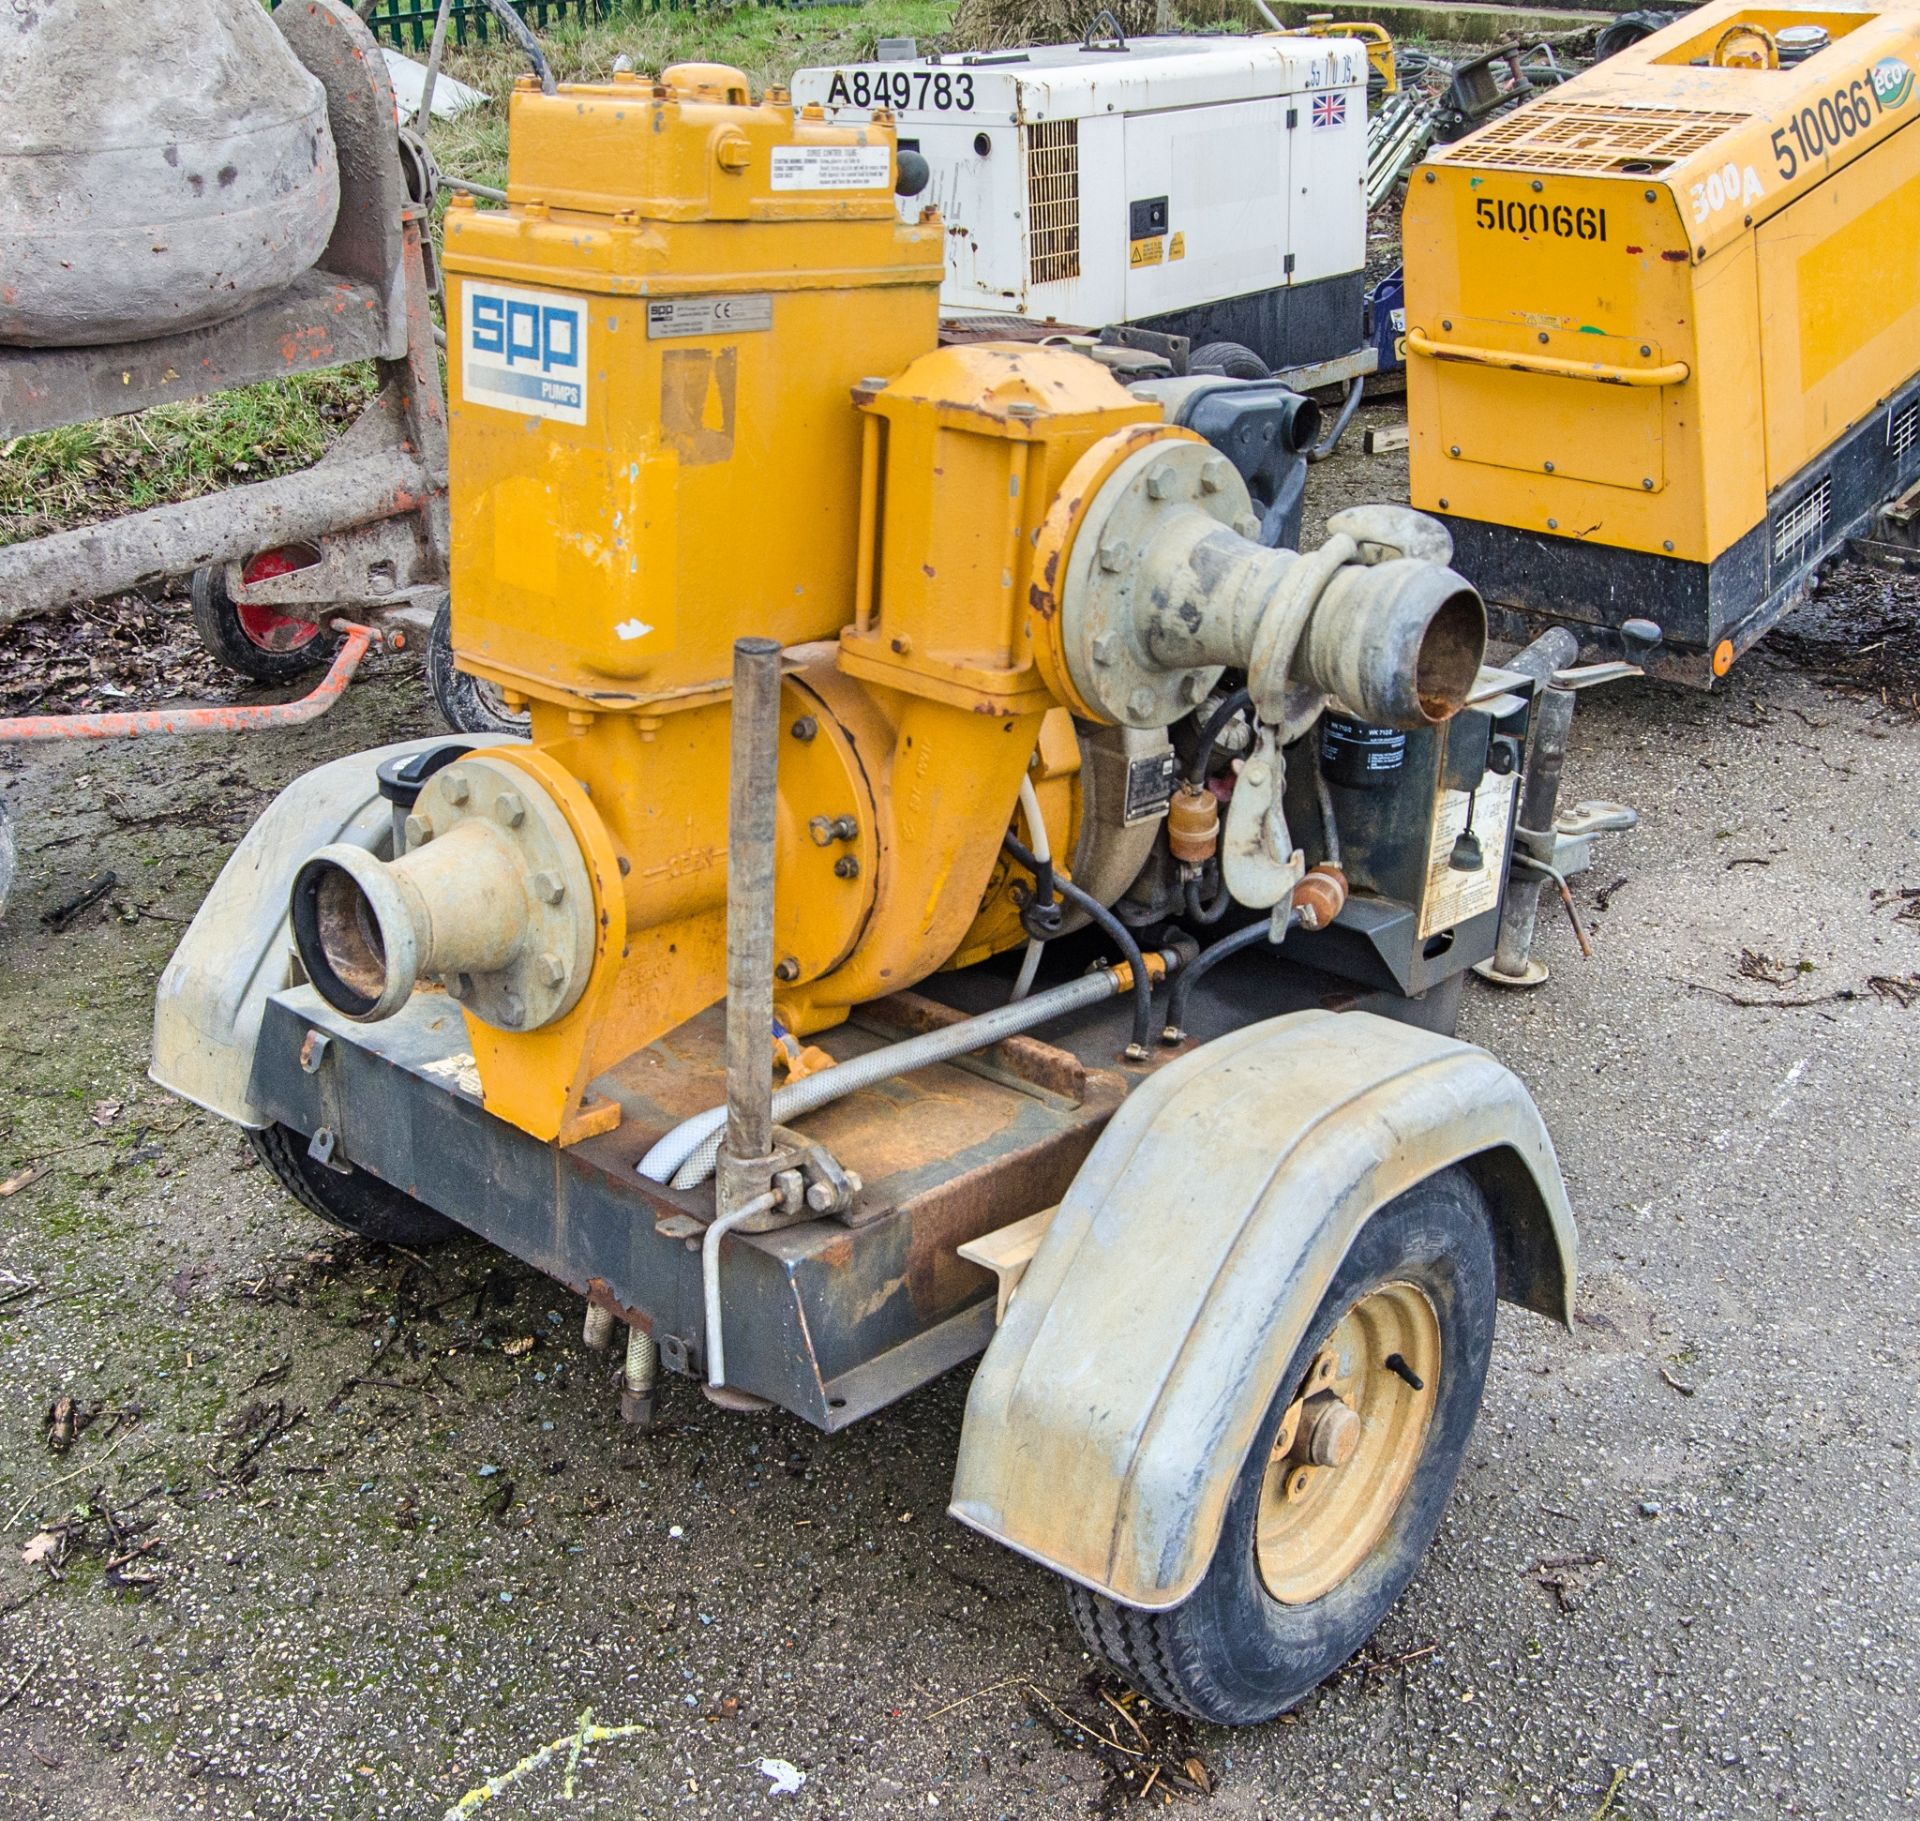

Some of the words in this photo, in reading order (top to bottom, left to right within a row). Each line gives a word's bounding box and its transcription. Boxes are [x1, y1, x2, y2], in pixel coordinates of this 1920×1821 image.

[828, 71, 974, 111] A849783
[1771, 69, 1883, 180] 5100661
[1477, 198, 1607, 242] 5100661
[541, 382, 578, 404] PUMPS
